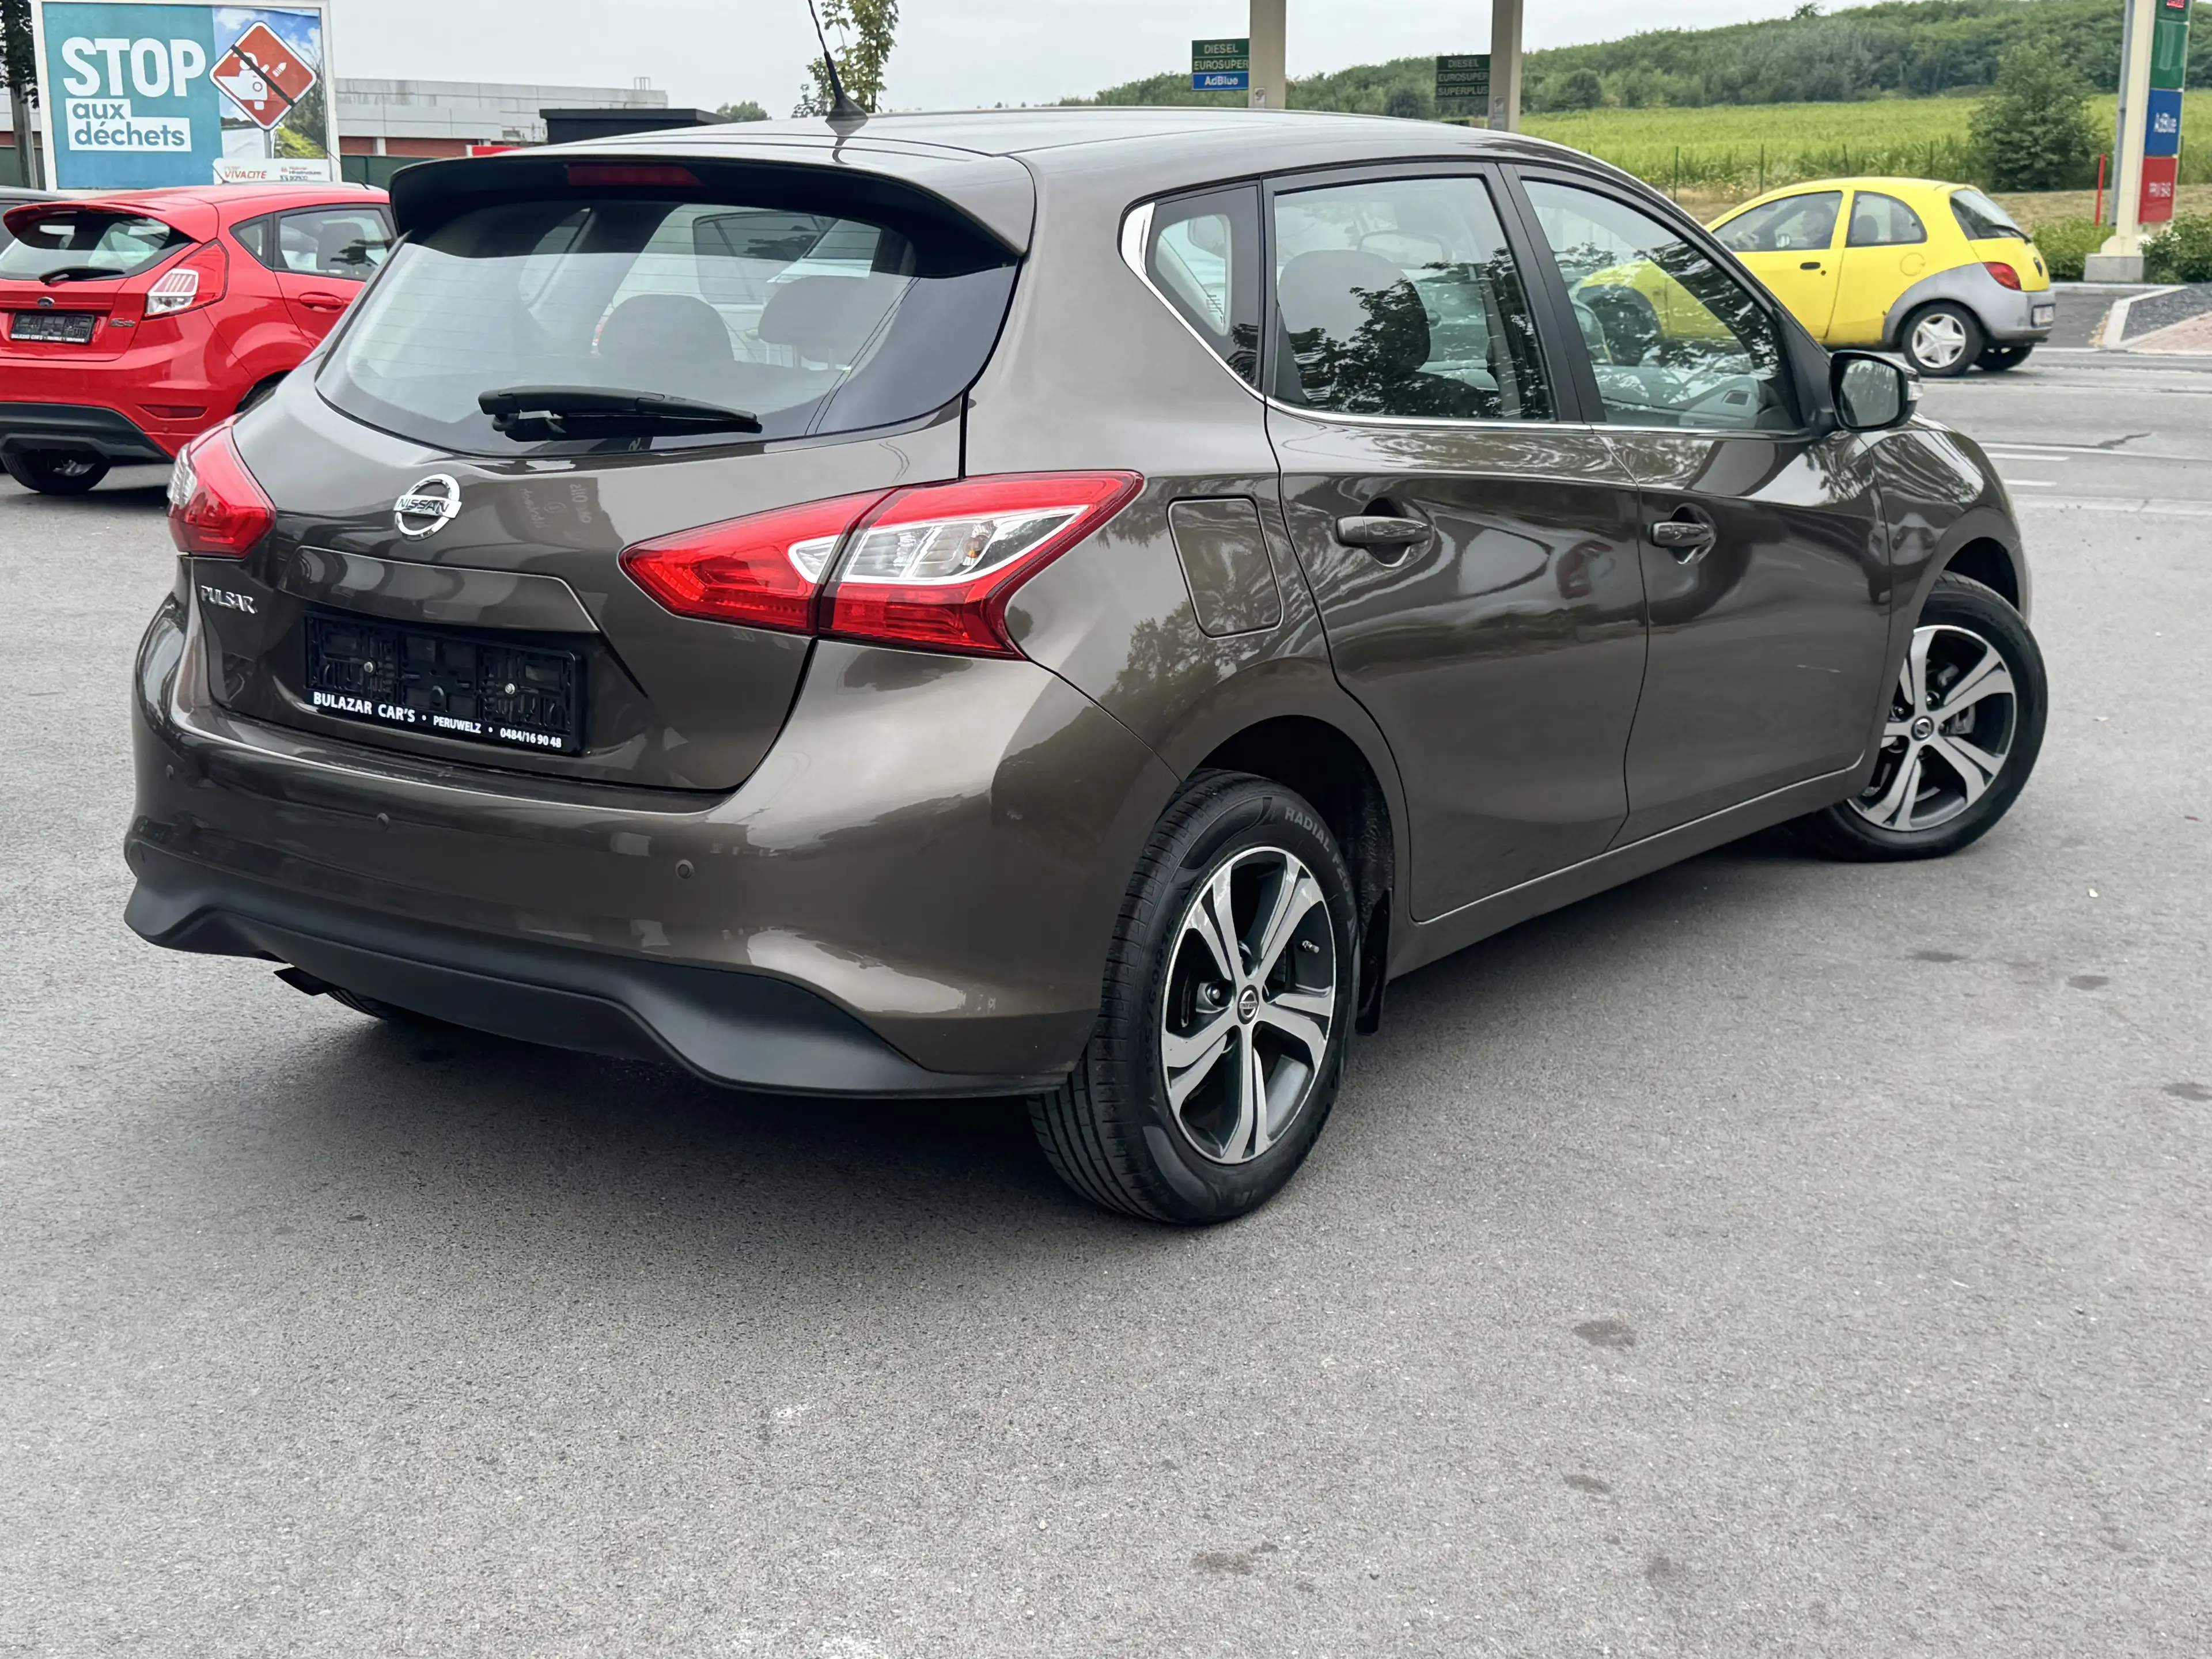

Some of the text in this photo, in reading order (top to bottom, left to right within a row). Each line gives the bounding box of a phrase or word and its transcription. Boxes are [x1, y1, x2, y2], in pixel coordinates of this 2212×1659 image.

[1204, 44, 1238, 54] DIESEL
[62, 37, 206, 97] STOP
[1194, 59, 1249, 70] EUROSUPER
[1448, 59, 1479, 69] DIESEL
[1205, 75, 1238, 86] AdBlue
[1438, 72, 1489, 82] EUROSUPER
[1437, 86, 1489, 96] SUPERPLUS
[73, 103, 125, 120] aux
[74, 120, 184, 146] déchets
[397, 498, 450, 514] NISSAN
[200, 585, 257, 614] PULSAR
[313, 691, 372, 715] BULAZAR
[433, 715, 481, 734] PERUWELZ
[1285, 806, 1330, 853] RADIAL
